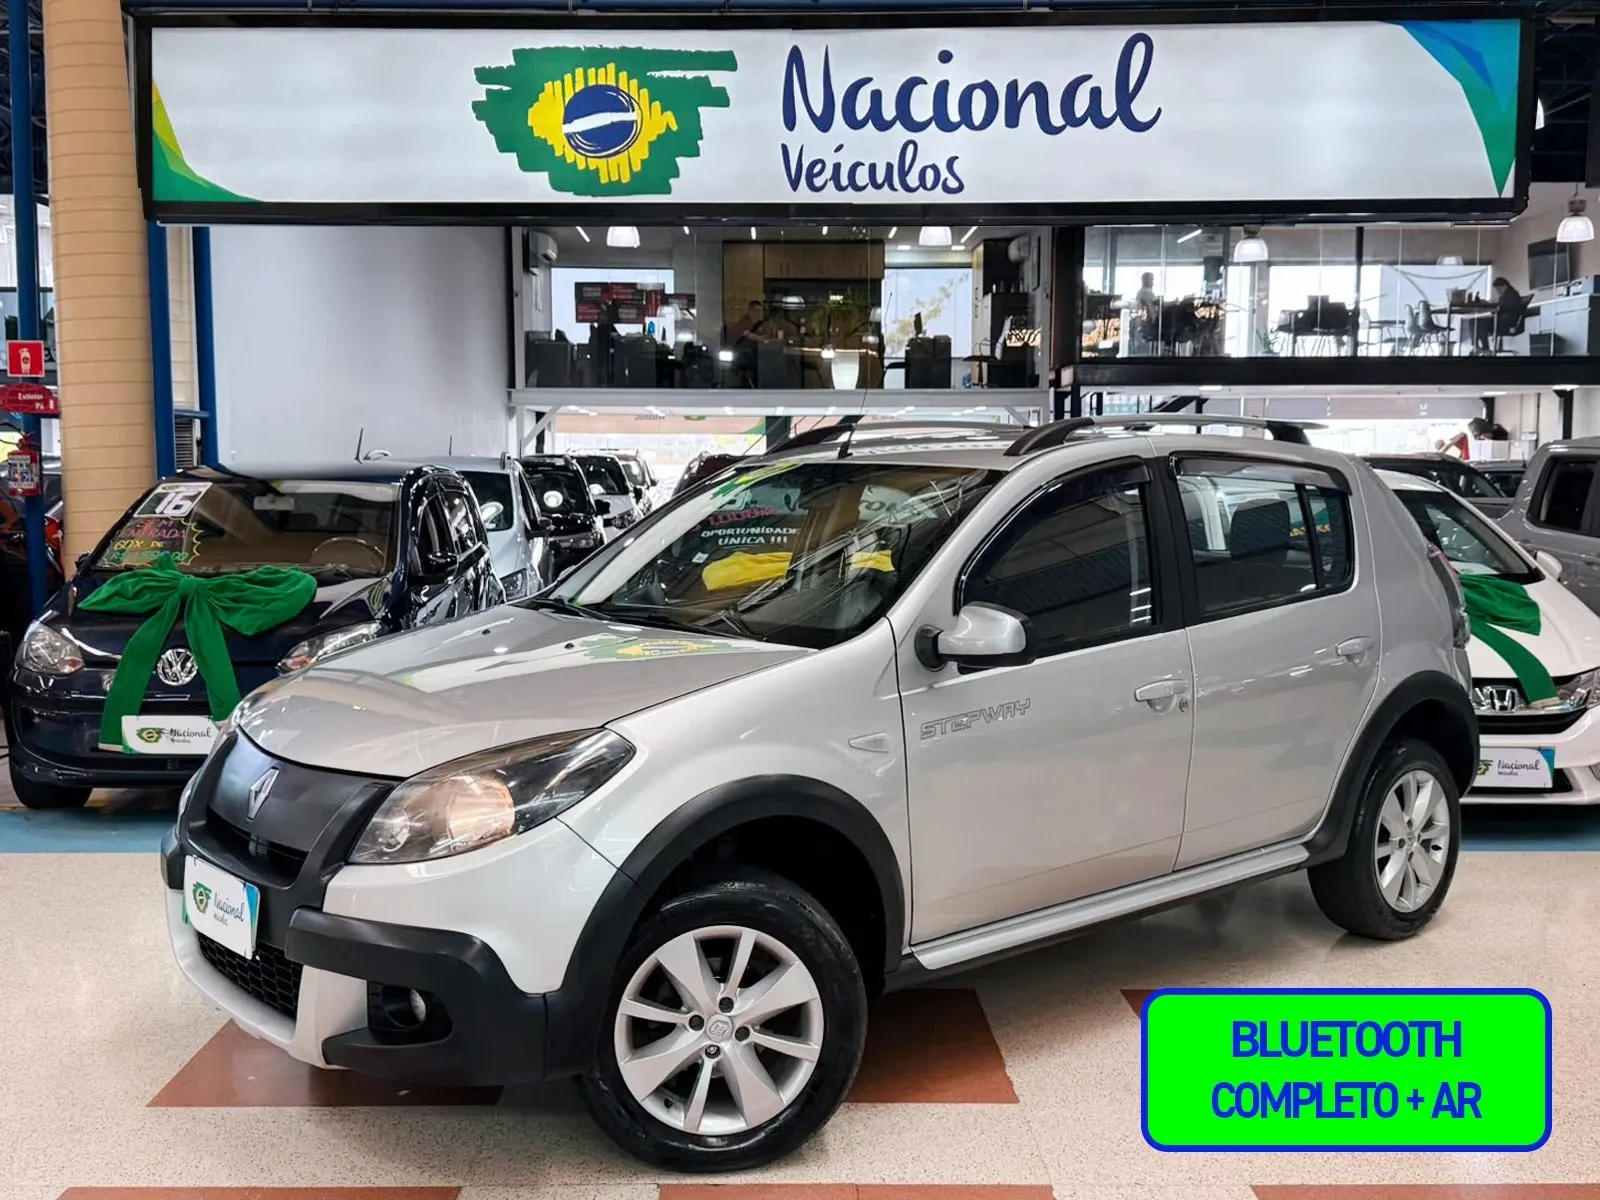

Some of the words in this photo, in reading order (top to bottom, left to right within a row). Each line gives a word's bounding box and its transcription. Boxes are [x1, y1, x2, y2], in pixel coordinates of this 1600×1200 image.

[782, 32, 1162, 135] Nacional
[781, 139, 965, 194] Veículos
[154, 491, 198, 515] 16
[169, 728, 212, 738] Nacional
[920, 698, 1030, 740] STEPWAY
[1497, 760, 1540, 770] Nacional
[214, 891, 245, 922] Nacional
